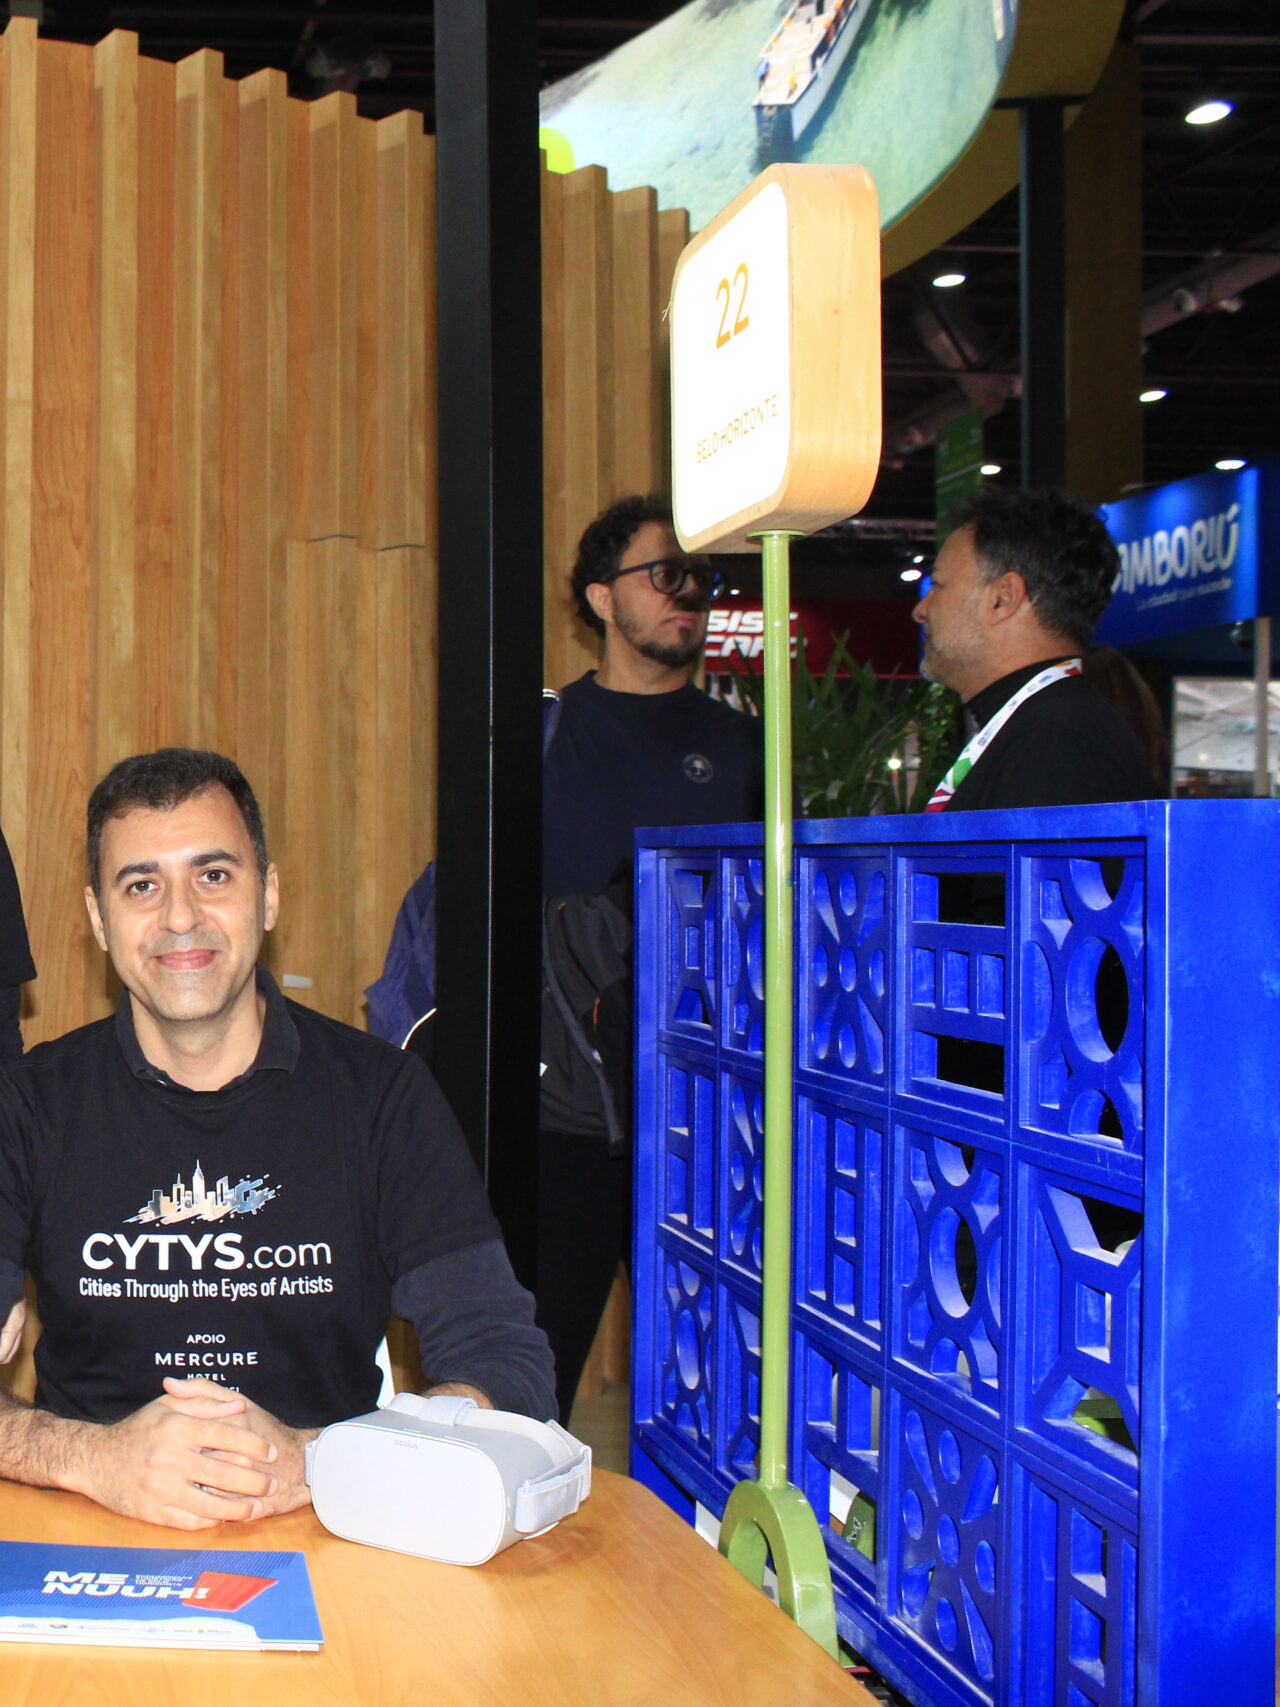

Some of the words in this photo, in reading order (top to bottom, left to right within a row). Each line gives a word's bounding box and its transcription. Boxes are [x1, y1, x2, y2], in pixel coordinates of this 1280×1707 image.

[715, 262, 750, 350] 22
[696, 432, 719, 463] BELO
[720, 393, 778, 449] HORIZONTE
[82, 1232, 332, 1271] CYTYS.com
[79, 1277, 122, 1298] Cities
[124, 1278, 189, 1302] Through
[192, 1278, 219, 1298] the
[221, 1278, 258, 1302] Eyes
[261, 1276, 277, 1297] of
[279, 1275, 334, 1296] Artists
[186, 1333, 226, 1344] APOIO
[154, 1351, 258, 1367] MERCURE
[43, 1570, 130, 1585] ME
[41, 1581, 210, 1599] NUUH!
